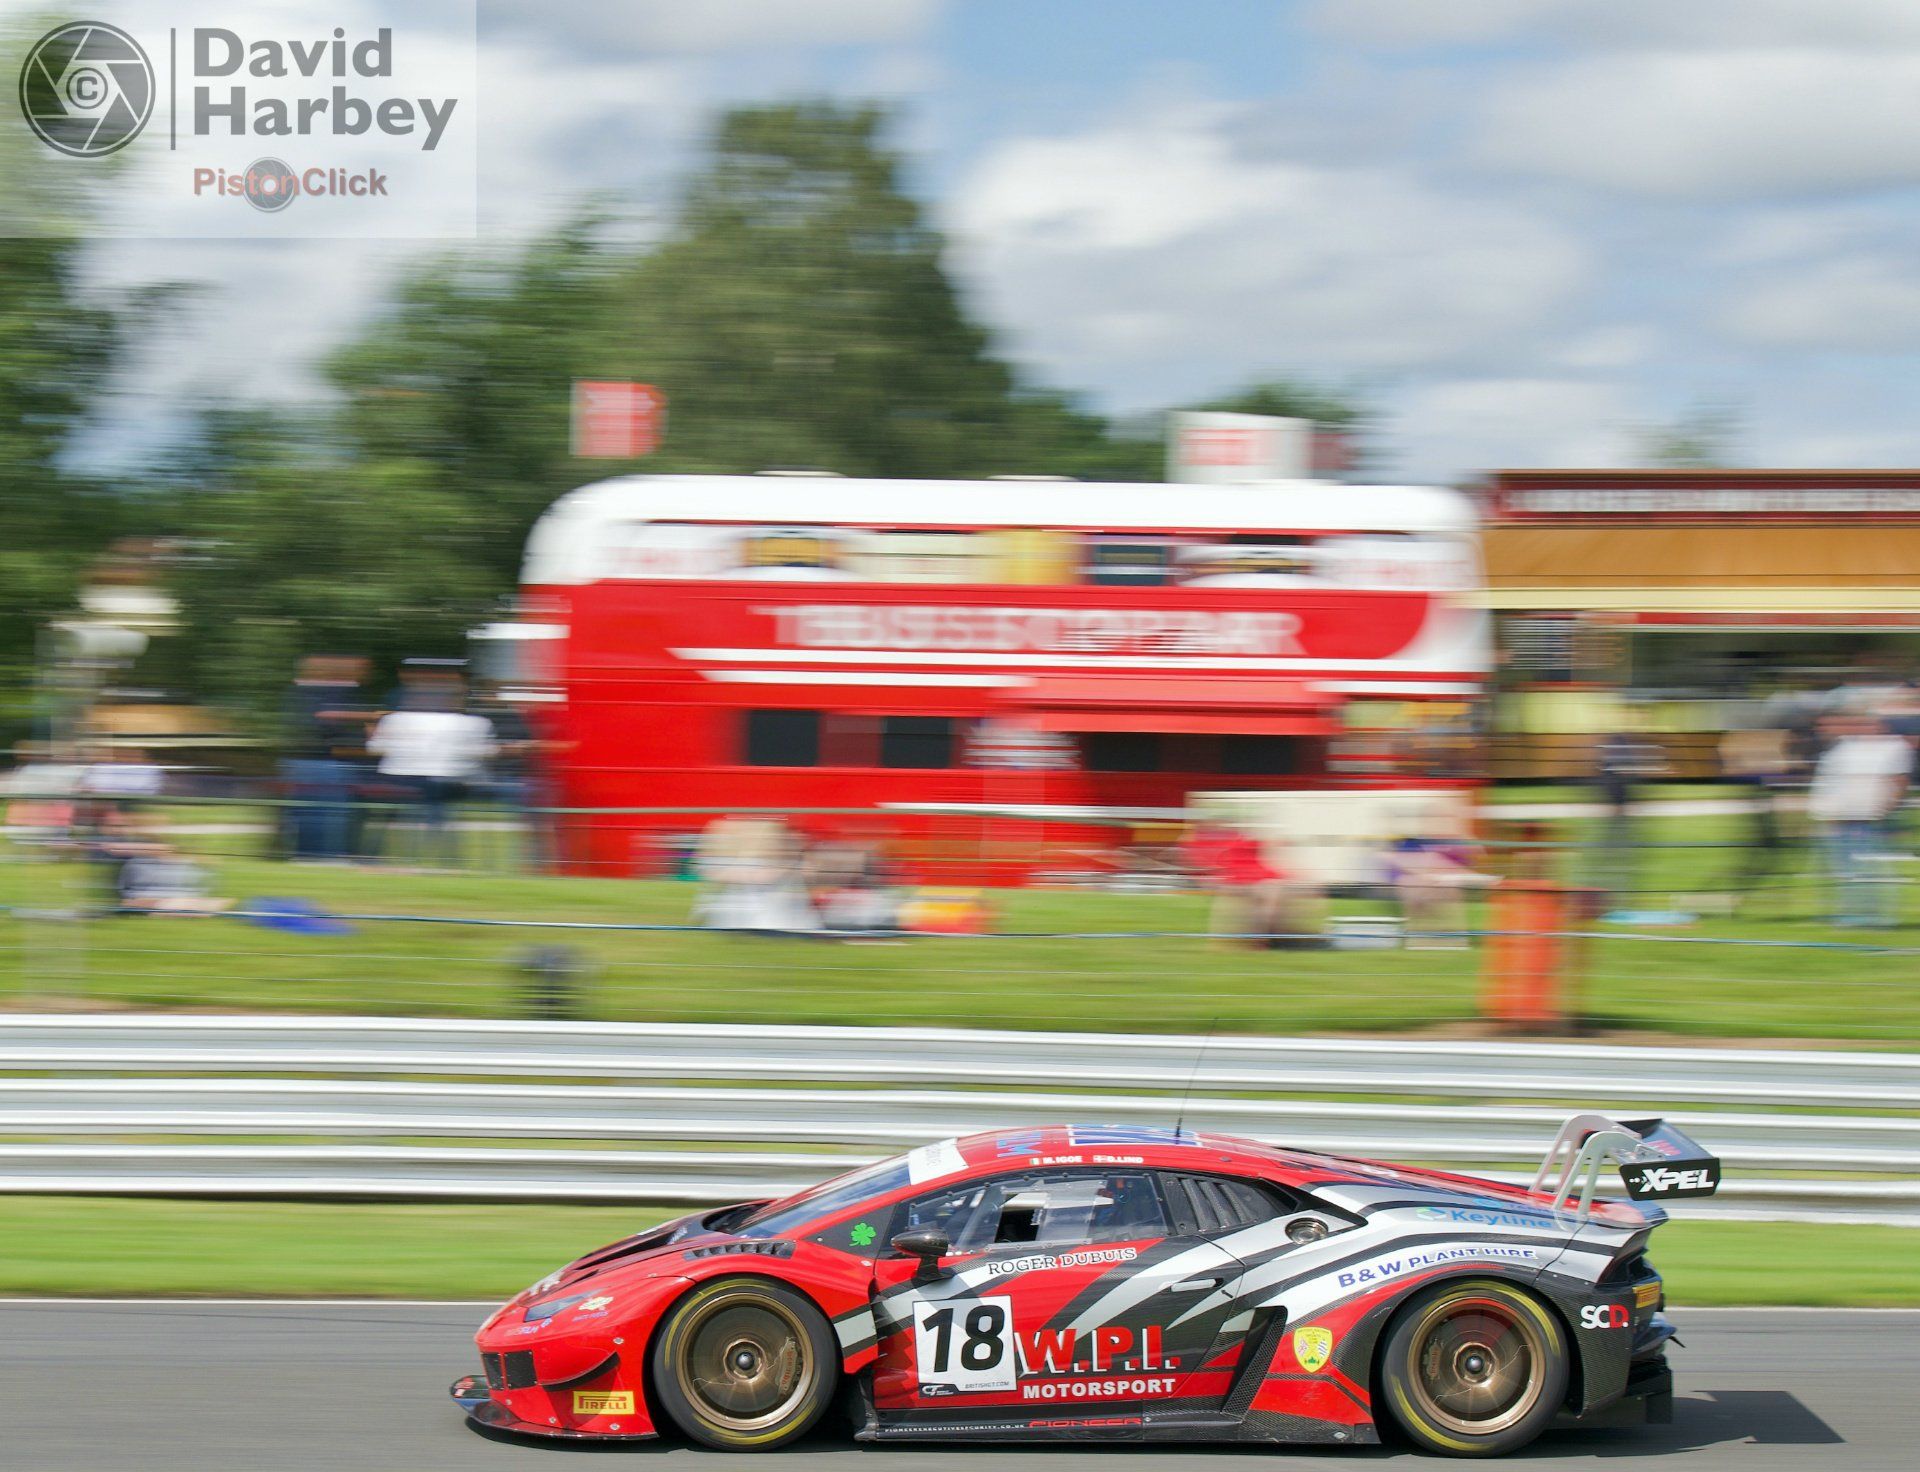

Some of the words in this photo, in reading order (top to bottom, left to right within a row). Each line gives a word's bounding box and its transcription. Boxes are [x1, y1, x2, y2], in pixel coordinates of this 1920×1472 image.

[1639, 1167, 1714, 1193] XPEL
[1451, 1210, 1553, 1229] Keyline
[988, 1256, 1056, 1275] ROGER
[1061, 1248, 1136, 1266] DUBUIS
[1338, 1260, 1401, 1288] B&W
[1408, 1248, 1478, 1268] PLANT
[922, 1304, 1005, 1373] 18
[1023, 1378, 1176, 1399] MOTORSPORT
[578, 1395, 628, 1410] PIRELLI
[1028, 1417, 1142, 1429] PIONEER
